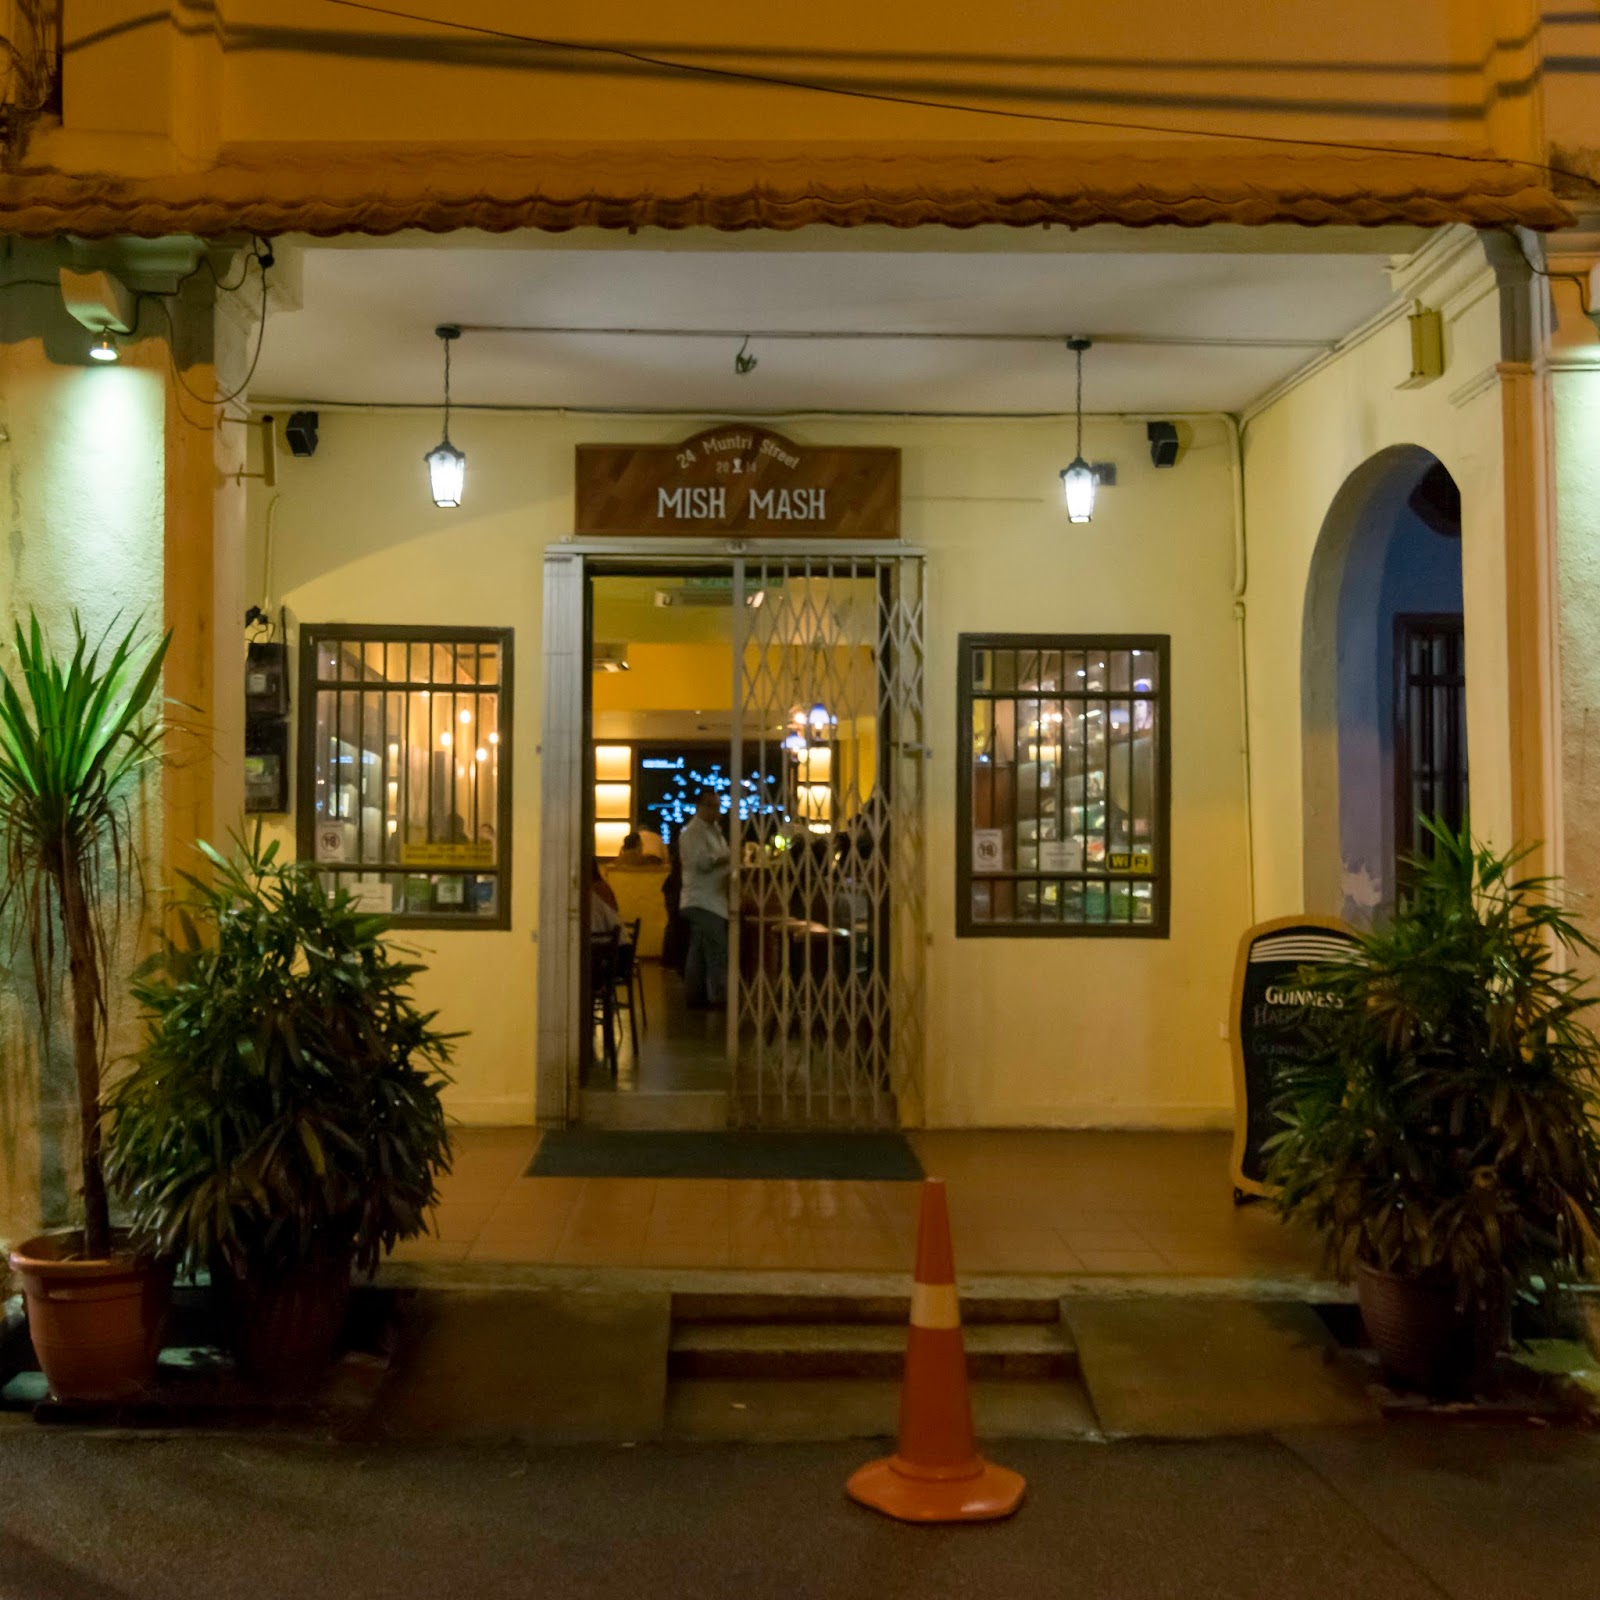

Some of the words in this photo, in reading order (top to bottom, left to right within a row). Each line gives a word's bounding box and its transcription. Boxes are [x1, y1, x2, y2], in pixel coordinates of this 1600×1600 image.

[676, 449, 696, 469] 24
[703, 434, 753, 454] Muntri
[760, 439, 801, 469] Street
[657, 486, 726, 519] MISH
[748, 488, 826, 520] MASH
